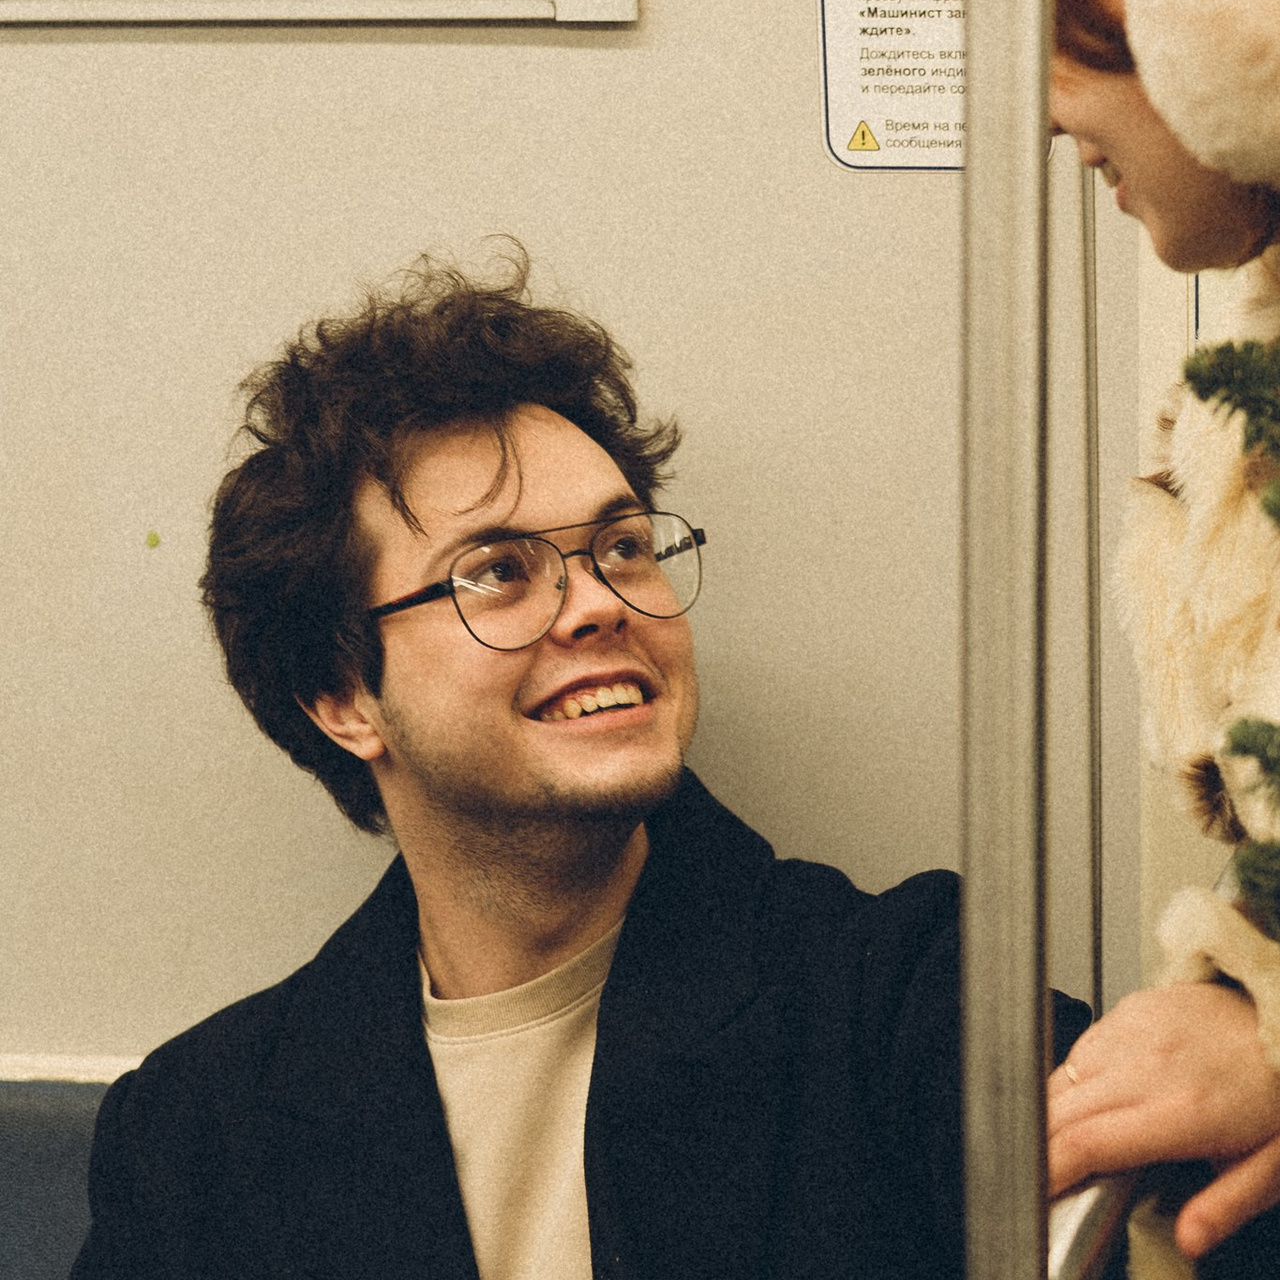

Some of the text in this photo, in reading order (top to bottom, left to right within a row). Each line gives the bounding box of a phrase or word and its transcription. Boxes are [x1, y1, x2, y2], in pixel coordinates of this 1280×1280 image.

[860, 48, 934, 61] Дождитесь
[861, 65, 925, 77] зелёного
[862, 85, 869, 93] и
[874, 83, 945, 96] передайте
[885, 120, 928, 132] Время
[934, 123, 949, 131] на
[886, 135, 962, 150] сообщения
